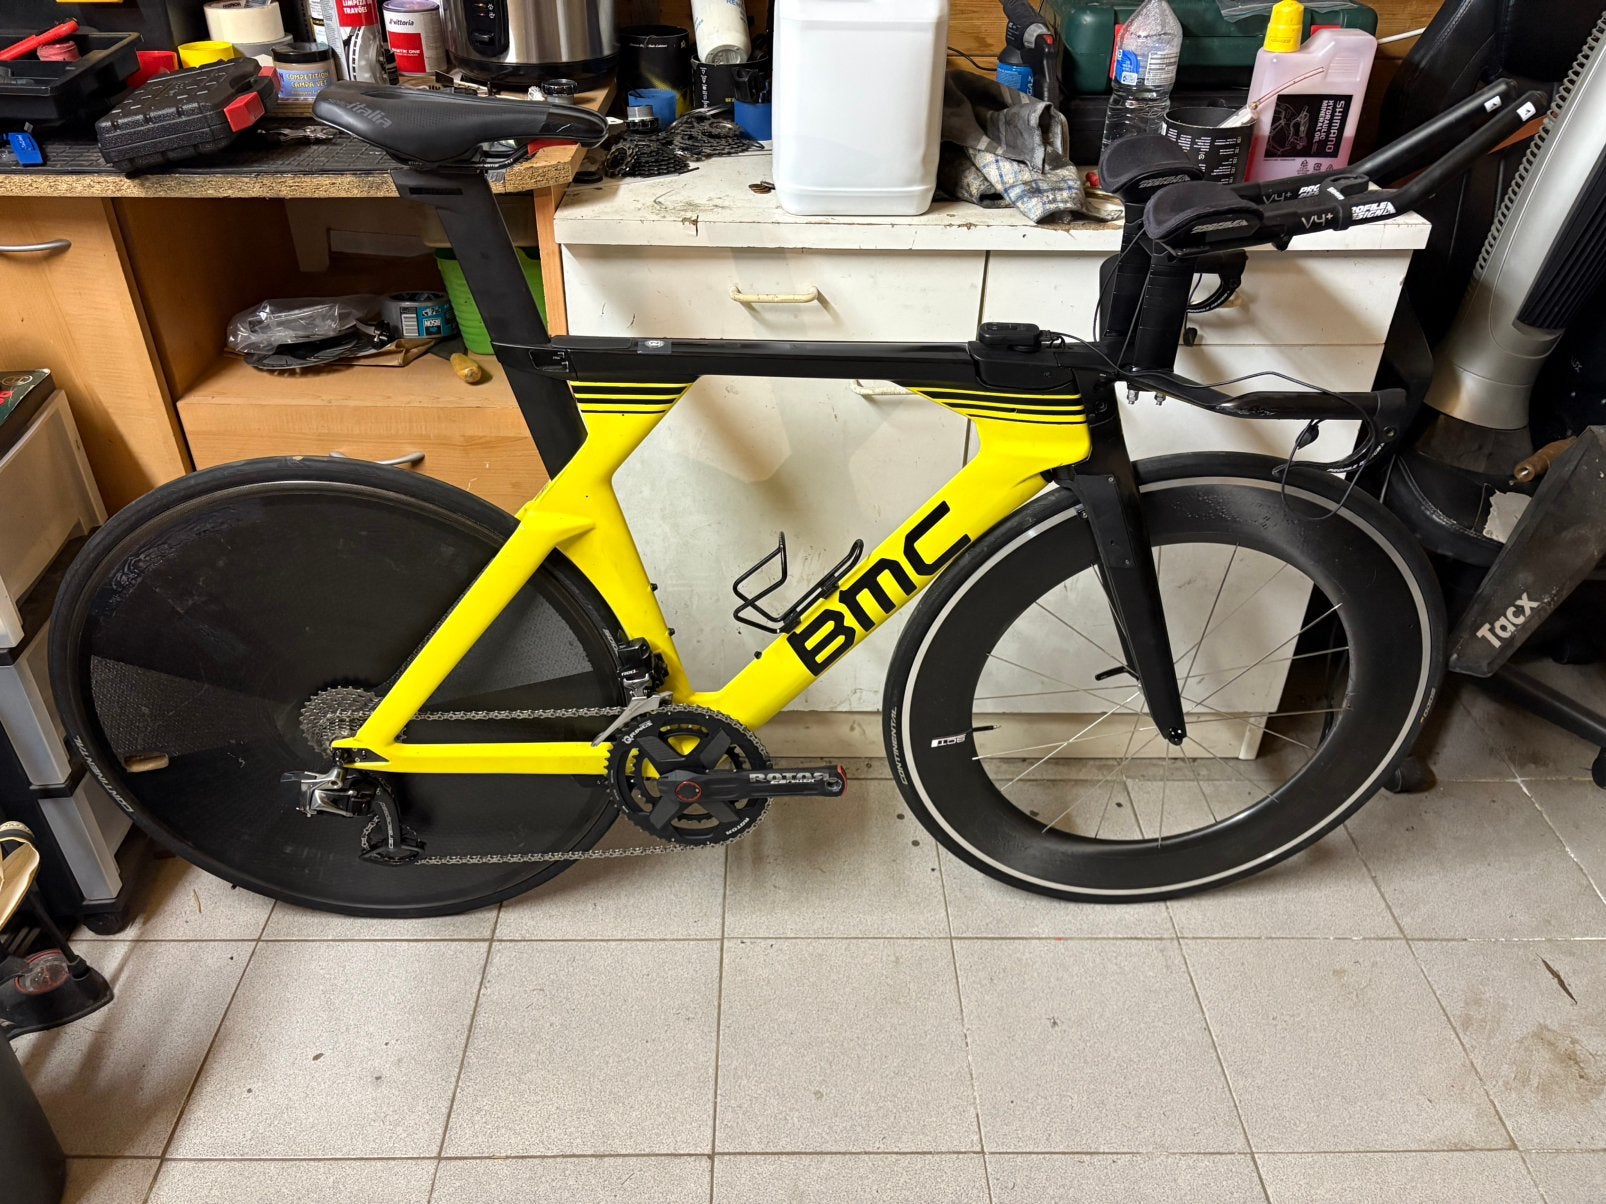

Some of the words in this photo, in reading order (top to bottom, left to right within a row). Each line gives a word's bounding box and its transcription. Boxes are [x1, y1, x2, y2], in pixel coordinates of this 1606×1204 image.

[343, 6, 368, 14] TRAVÕES
[286, 71, 329, 81] COMPETITION
[346, 101, 393, 129] italia
[1316, 100, 1329, 131] MINERAL
[1319, 100, 1335, 140] HYDRAULIC
[1325, 100, 1345, 153] SHIMANO
[1301, 212, 1334, 229] V4+
[786, 500, 972, 677] BMC
[1475, 591, 1541, 649] Tacx
[890, 706, 909, 786] CONTINENTAL
[73, 735, 135, 812] CONTINENTAL
[749, 772, 830, 783] ROTOR
[724, 817, 750, 835] ROTOR
